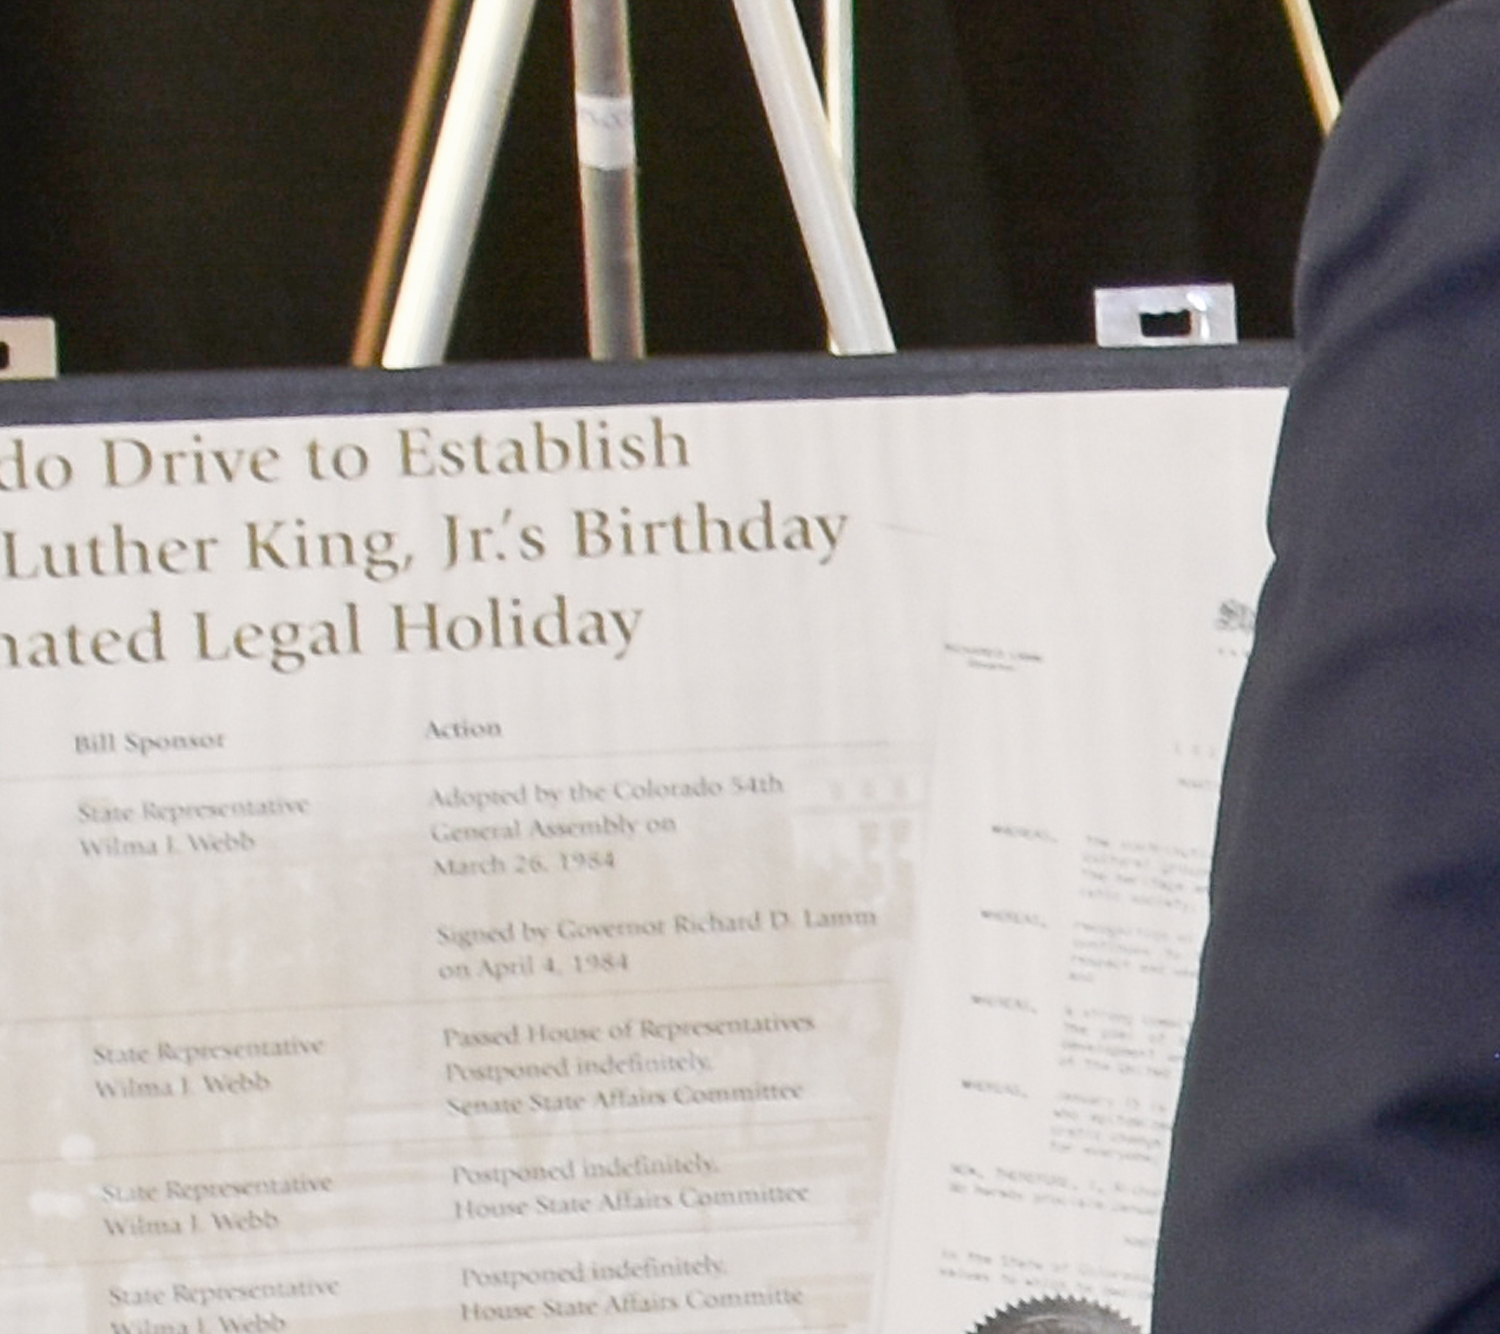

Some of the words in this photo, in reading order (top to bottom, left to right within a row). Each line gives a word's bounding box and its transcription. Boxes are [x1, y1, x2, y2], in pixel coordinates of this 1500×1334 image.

[103, 436, 281, 486] Drive
[305, 441, 370, 480] to
[398, 420, 689, 475] Establish
[2, 525, 219, 578] Luther
[246, 521, 413, 580] King,
[572, 502, 848, 562] Birthday
[194, 603, 361, 671] Legal
[392, 597, 641, 657] Holiday
[425, 721, 502, 738] Action
[74, 734, 116, 755] Bill
[124, 733, 225, 756] Sponsor
[428, 786, 529, 811] Adopted
[534, 784, 561, 807] by
[568, 782, 607, 802] the
[612, 777, 723, 800] Colorado
[77, 804, 135, 823] State
[141, 798, 310, 823] Representative
[430, 820, 521, 842] General
[529, 815, 637, 838] Assembly
[645, 818, 677, 833] on
[79, 837, 159, 856] Wilma
[187, 832, 257, 852] Webb
[432, 855, 508, 876] March
[558, 851, 616, 870] 1984
[436, 923, 515, 948] Signed
[521, 921, 549, 942] by
[556, 920, 666, 939] Governor
[673, 911, 763, 934] Richard
[803, 910, 878, 928] Lamm
[437, 964, 472, 980] on
[477, 956, 535, 981] April
[573, 953, 630, 973] 1984
[442, 1025, 520, 1047] Passed
[527, 1025, 601, 1042] House
[608, 1020, 633, 1040] of
[639, 1015, 816, 1040] Representatives
[92, 1046, 150, 1064] State
[156, 1038, 325, 1064] Representative
[444, 1057, 570, 1083] Postponed
[93, 1078, 174, 1098] Wilma
[202, 1072, 272, 1093] Webb
[446, 1099, 524, 1116] Senate
[528, 1094, 586, 1112] State
[594, 1088, 670, 1108] Affairs
[669, 1083, 804, 1104] Committee
[451, 1160, 577, 1186] Postponed
[101, 1185, 159, 1202] State
[165, 1175, 336, 1202] Representative
[451, 1200, 530, 1219] House
[534, 1197, 593, 1214] State
[597, 1190, 673, 1211] Affairs
[678, 1187, 809, 1207] Committee
[103, 1217, 183, 1236] Wilma
[211, 1210, 281, 1231] Webb
[461, 1263, 589, 1289] Postponed
[108, 1289, 165, 1306] State
[172, 1279, 339, 1305] Representative
[460, 1303, 535, 1321] House
[542, 1301, 600, 1317] State
[603, 1294, 680, 1314] Affairs
[217, 1312, 288, 1334] Webb
